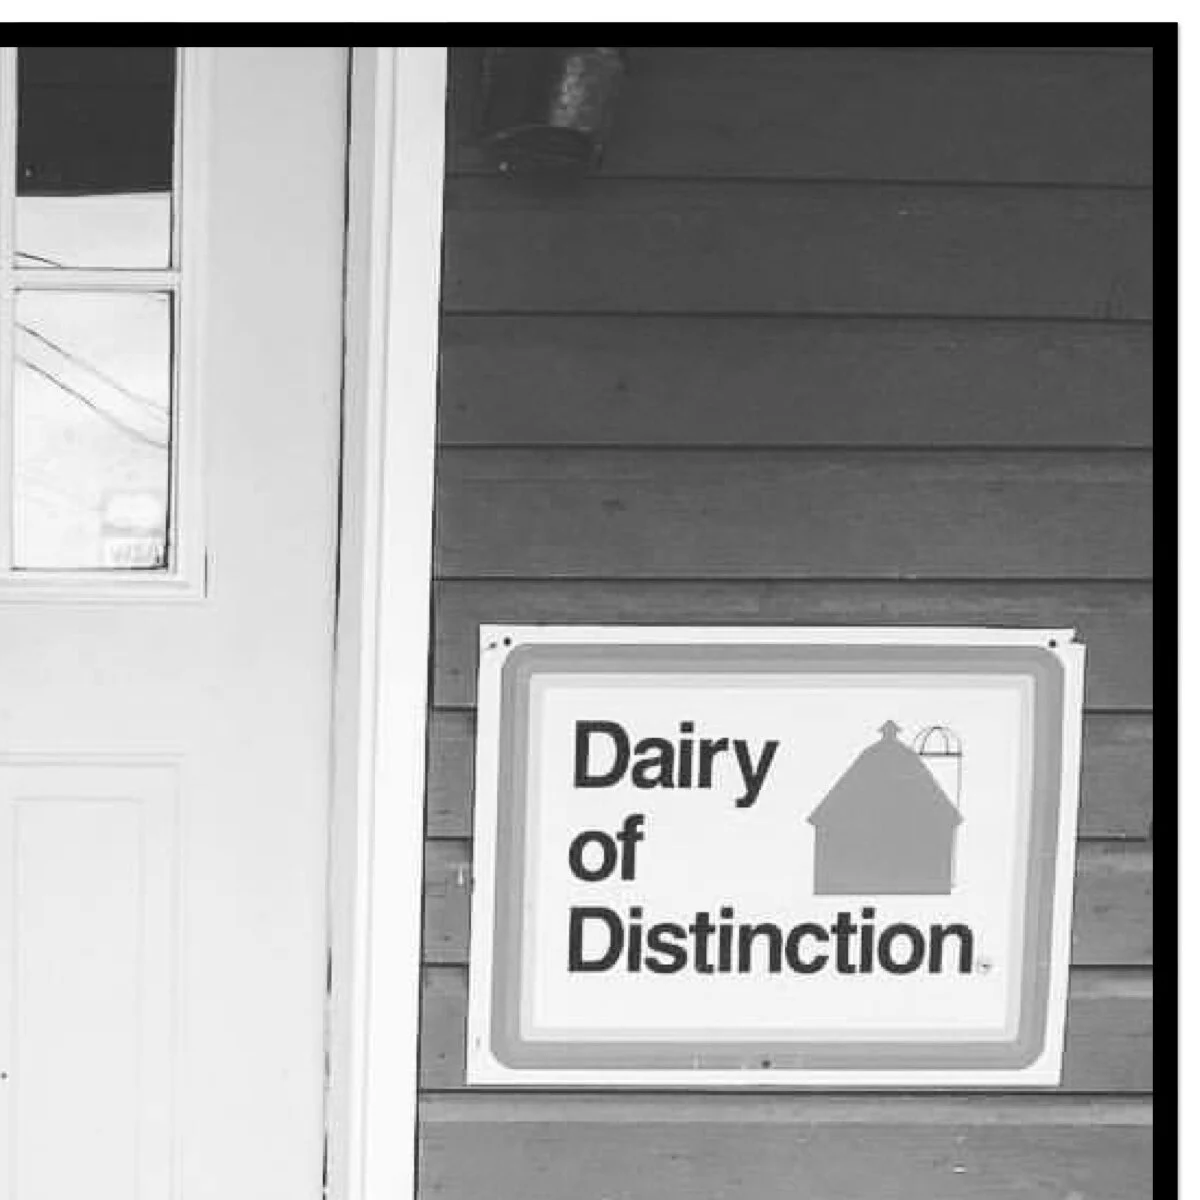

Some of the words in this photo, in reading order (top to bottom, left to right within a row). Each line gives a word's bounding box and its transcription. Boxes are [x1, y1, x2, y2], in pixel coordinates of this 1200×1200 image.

[572, 719, 780, 809] Dairy
[567, 813, 646, 882] of
[567, 906, 975, 975] Distinction
